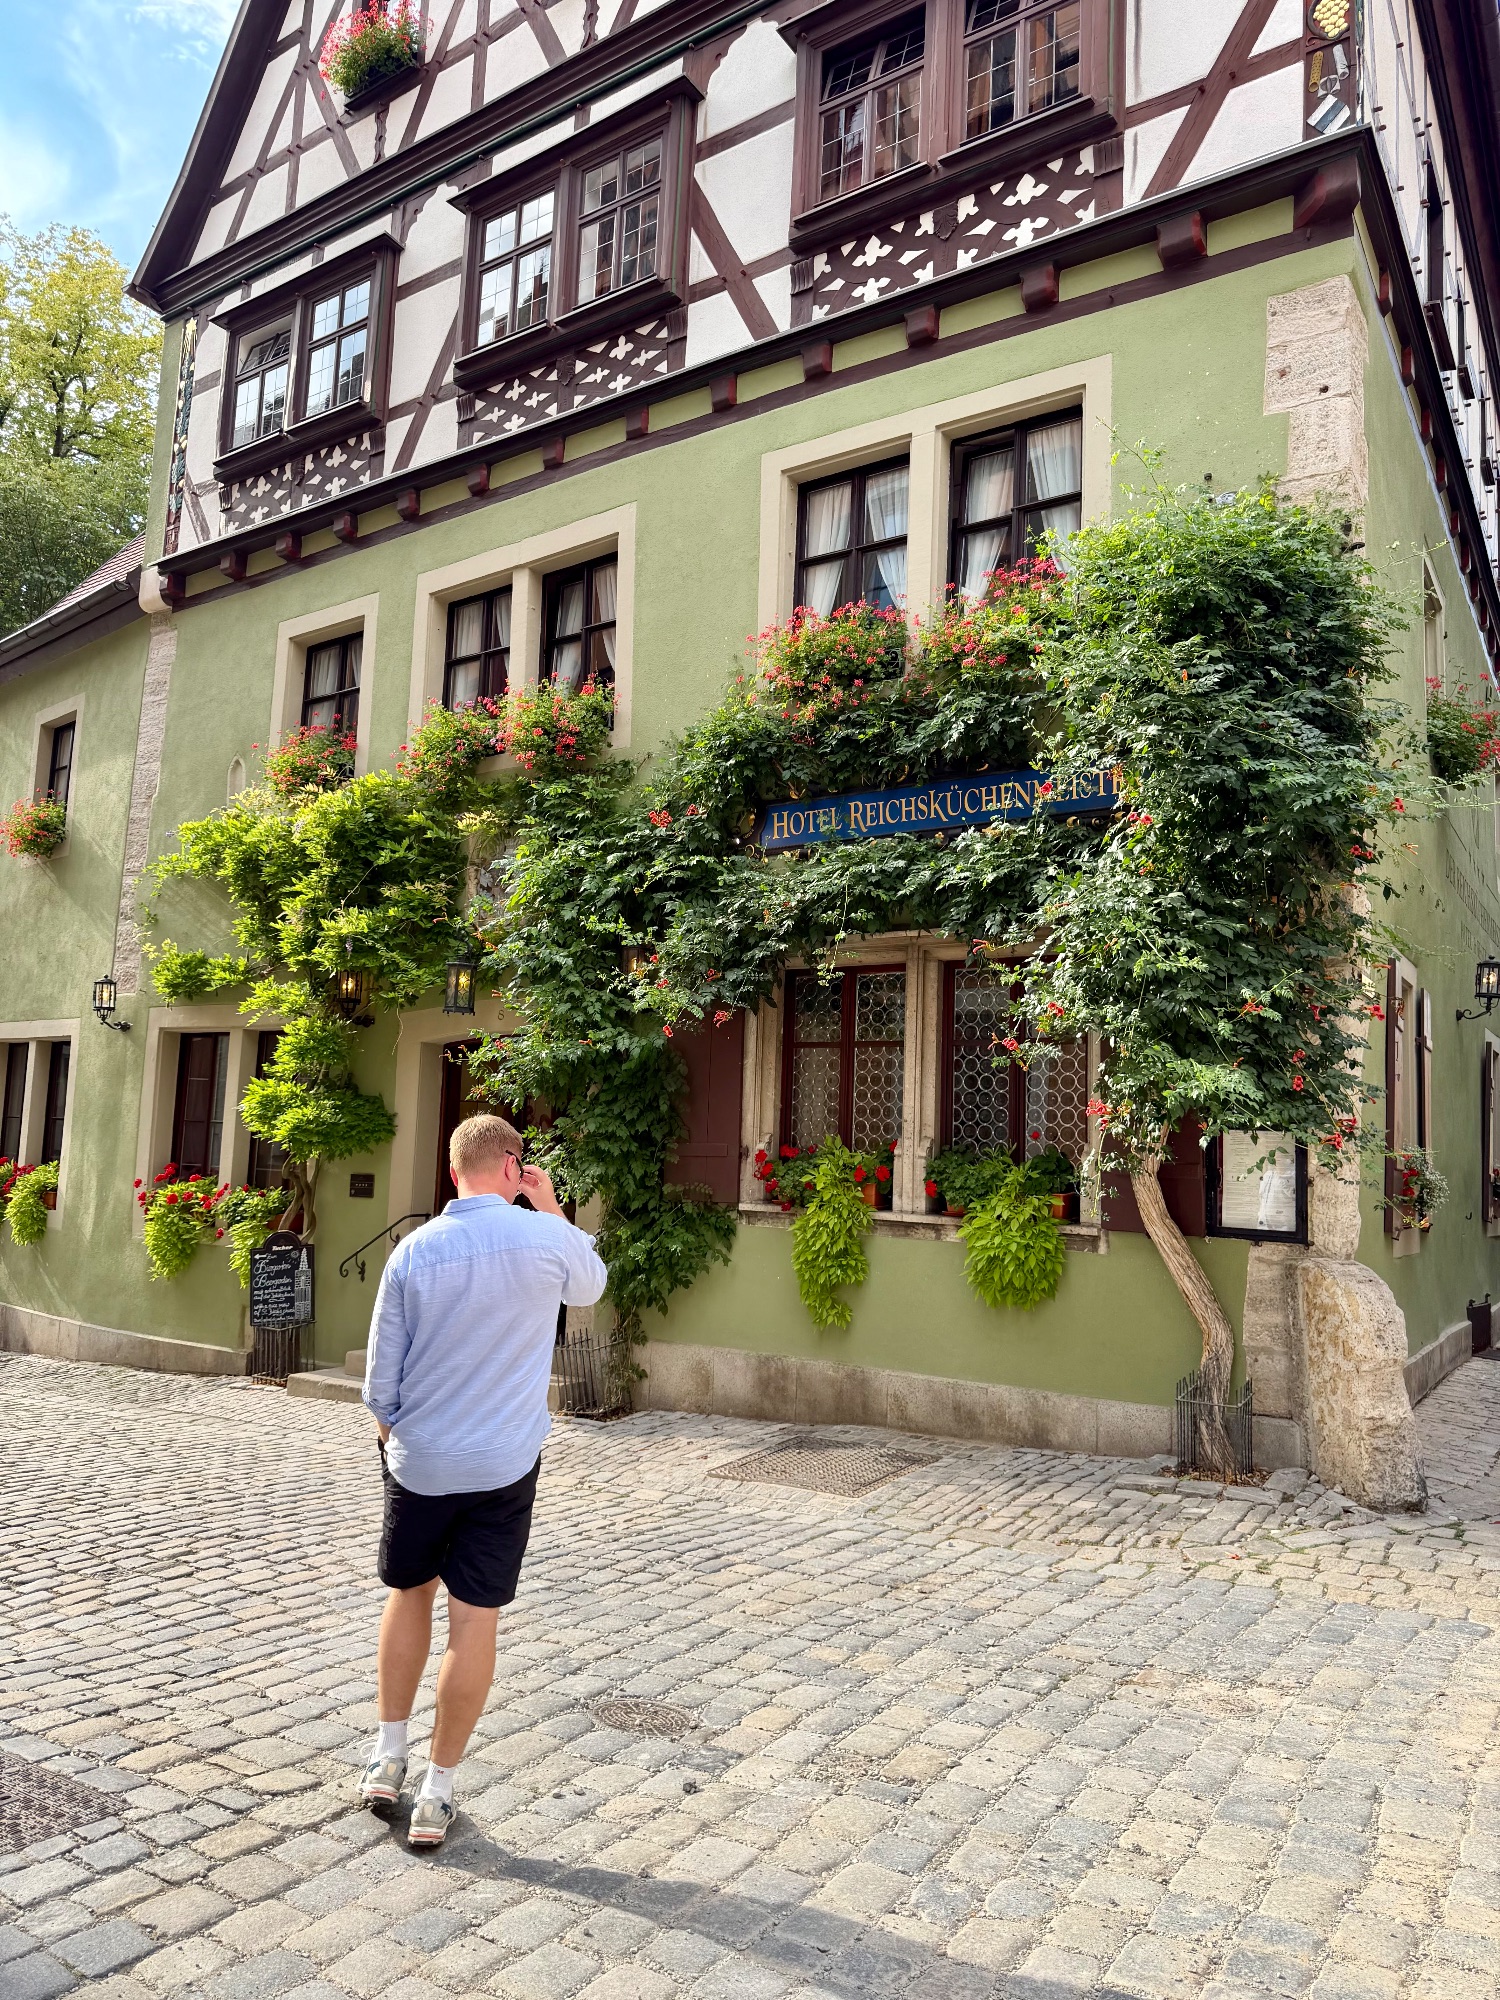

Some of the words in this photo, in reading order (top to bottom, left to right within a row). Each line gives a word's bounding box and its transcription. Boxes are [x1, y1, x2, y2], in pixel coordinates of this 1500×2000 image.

[772, 806, 843, 840] HOTEL
[848, 768, 1126, 833] REICHSKÜCHENMEISTE
[497, 1009, 505, 1021] 8
